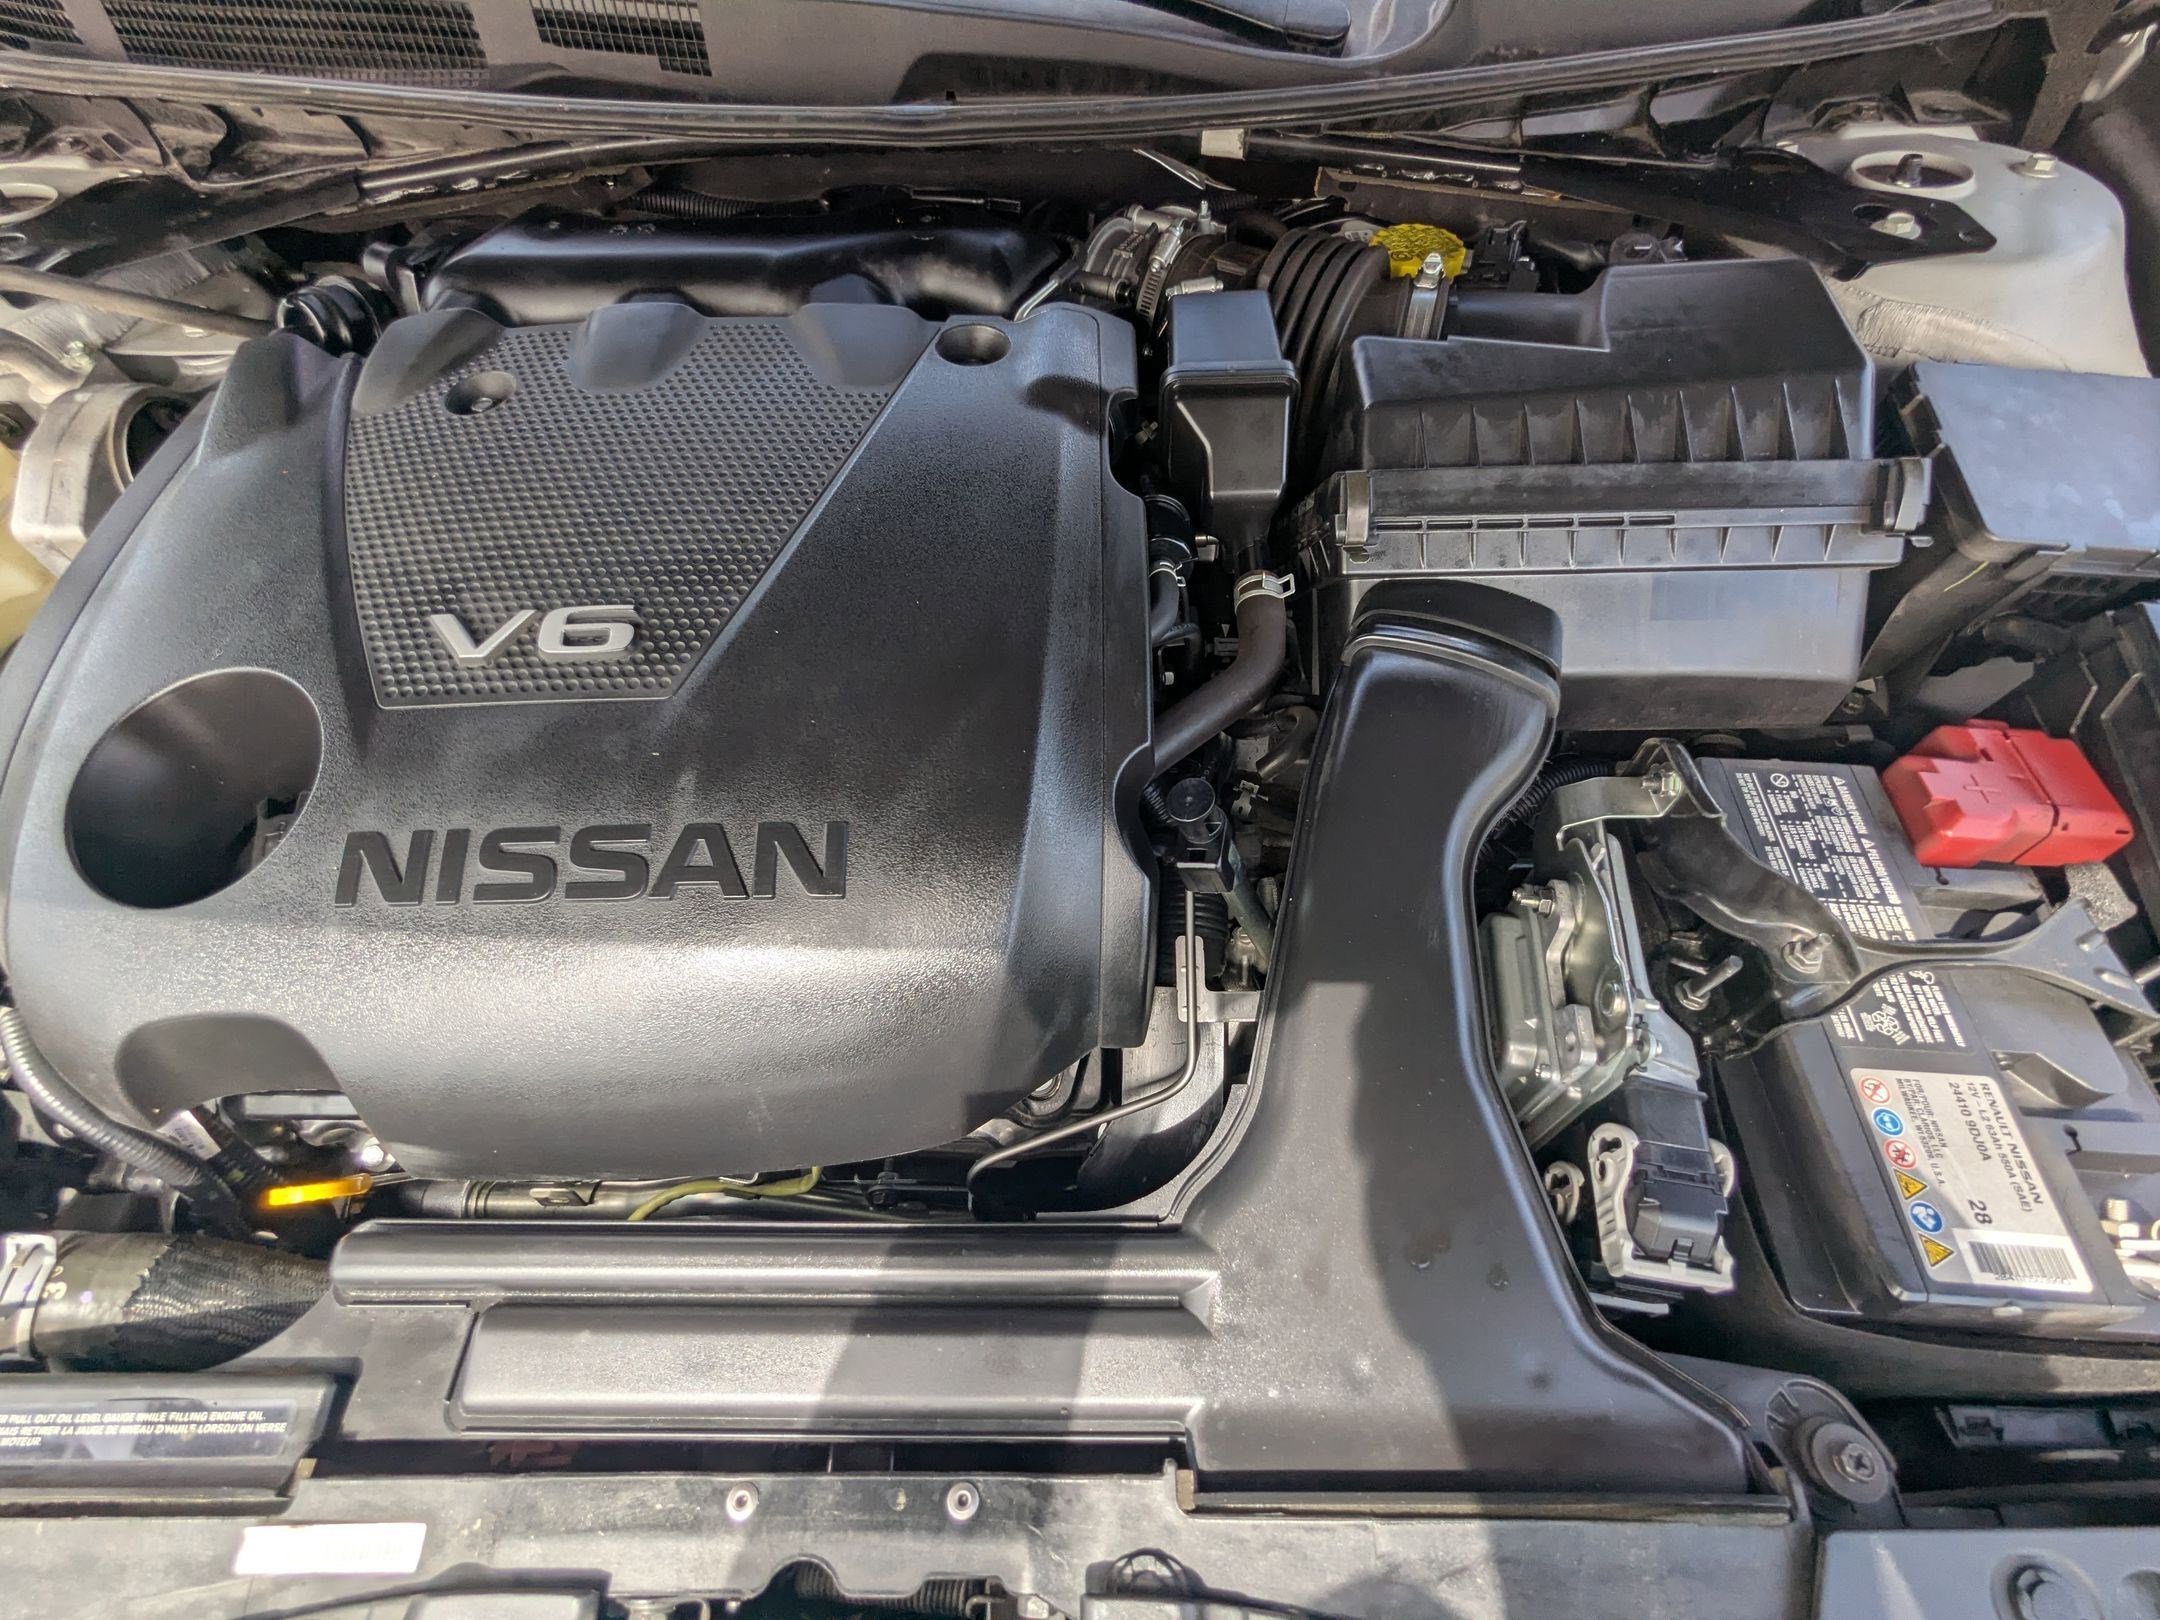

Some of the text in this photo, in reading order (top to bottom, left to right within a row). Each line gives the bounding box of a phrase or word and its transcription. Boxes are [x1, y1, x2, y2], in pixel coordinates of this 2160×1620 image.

[430, 604, 642, 667] V6
[334, 820, 848, 907] NISSAN
[1947, 1081, 1973, 1116] 24410
[1965, 1082, 1980, 1098] 12V
[1977, 1109, 1990, 1121] L2
[2008, 1181, 2033, 1212] (SAE)
[1978, 1083, 2044, 1204] RENAULT NISSAN
[1967, 1198, 1993, 1224] 28
[34, 1413, 56, 1424] OUT
[168, 1411, 208, 1422] FILLING
[209, 1410, 247, 1422] ENGINE
